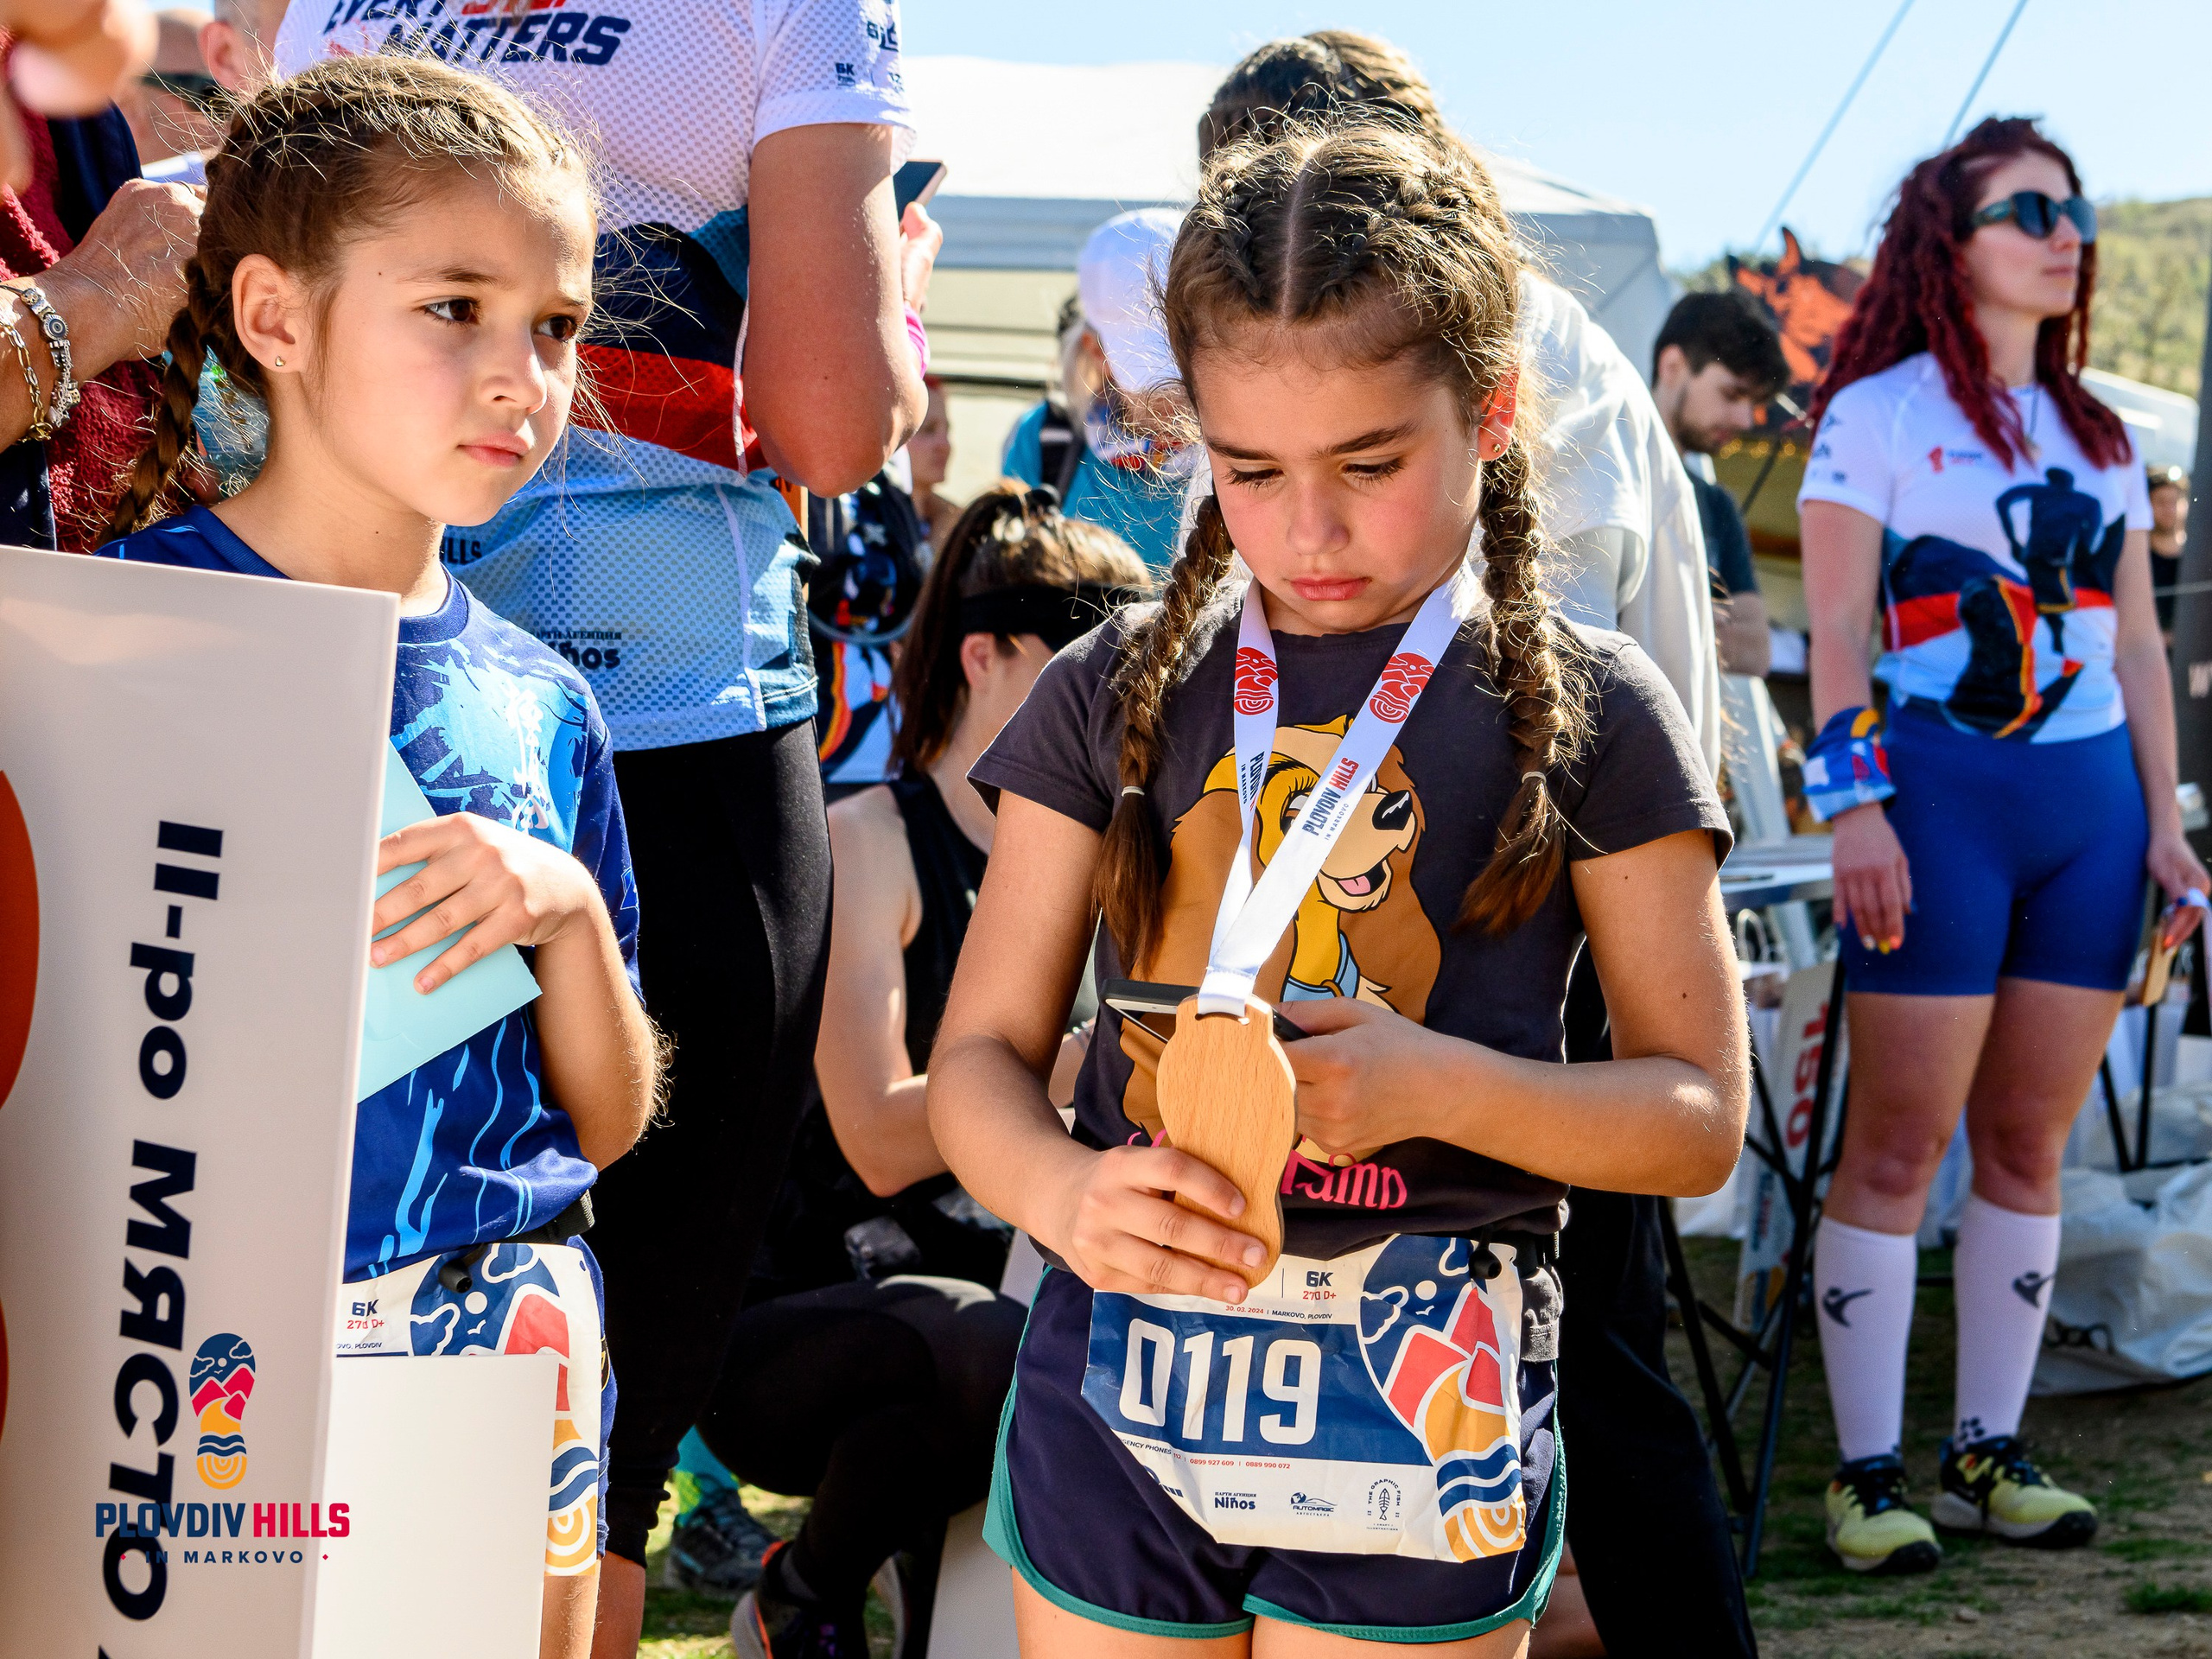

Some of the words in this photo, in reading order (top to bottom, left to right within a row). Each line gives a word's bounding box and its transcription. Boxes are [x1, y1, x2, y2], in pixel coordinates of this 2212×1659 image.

[439, 536, 483, 566] ILLS
[1301, 787, 1342, 836] PLOVDIV
[1328, 756, 1360, 791] HILLS
[1329, 803, 1350, 833] MARKOVO
[1306, 1270, 1334, 1287] 6K
[1302, 1291, 1321, 1300] 270
[1323, 1290, 1338, 1300] D+
[352, 1299, 380, 1317] 6K
[1271, 1309, 1306, 1319] MARKOVO,
[371, 1319, 385, 1329] D+
[1118, 1318, 1323, 1446] 0119
[1121, 1439, 1145, 1449] GENCY
[1145, 1444, 1173, 1455] PHONES
[1214, 1497, 1256, 1510] Niños
[1293, 1504, 1335, 1513] AUTOMAGIC
